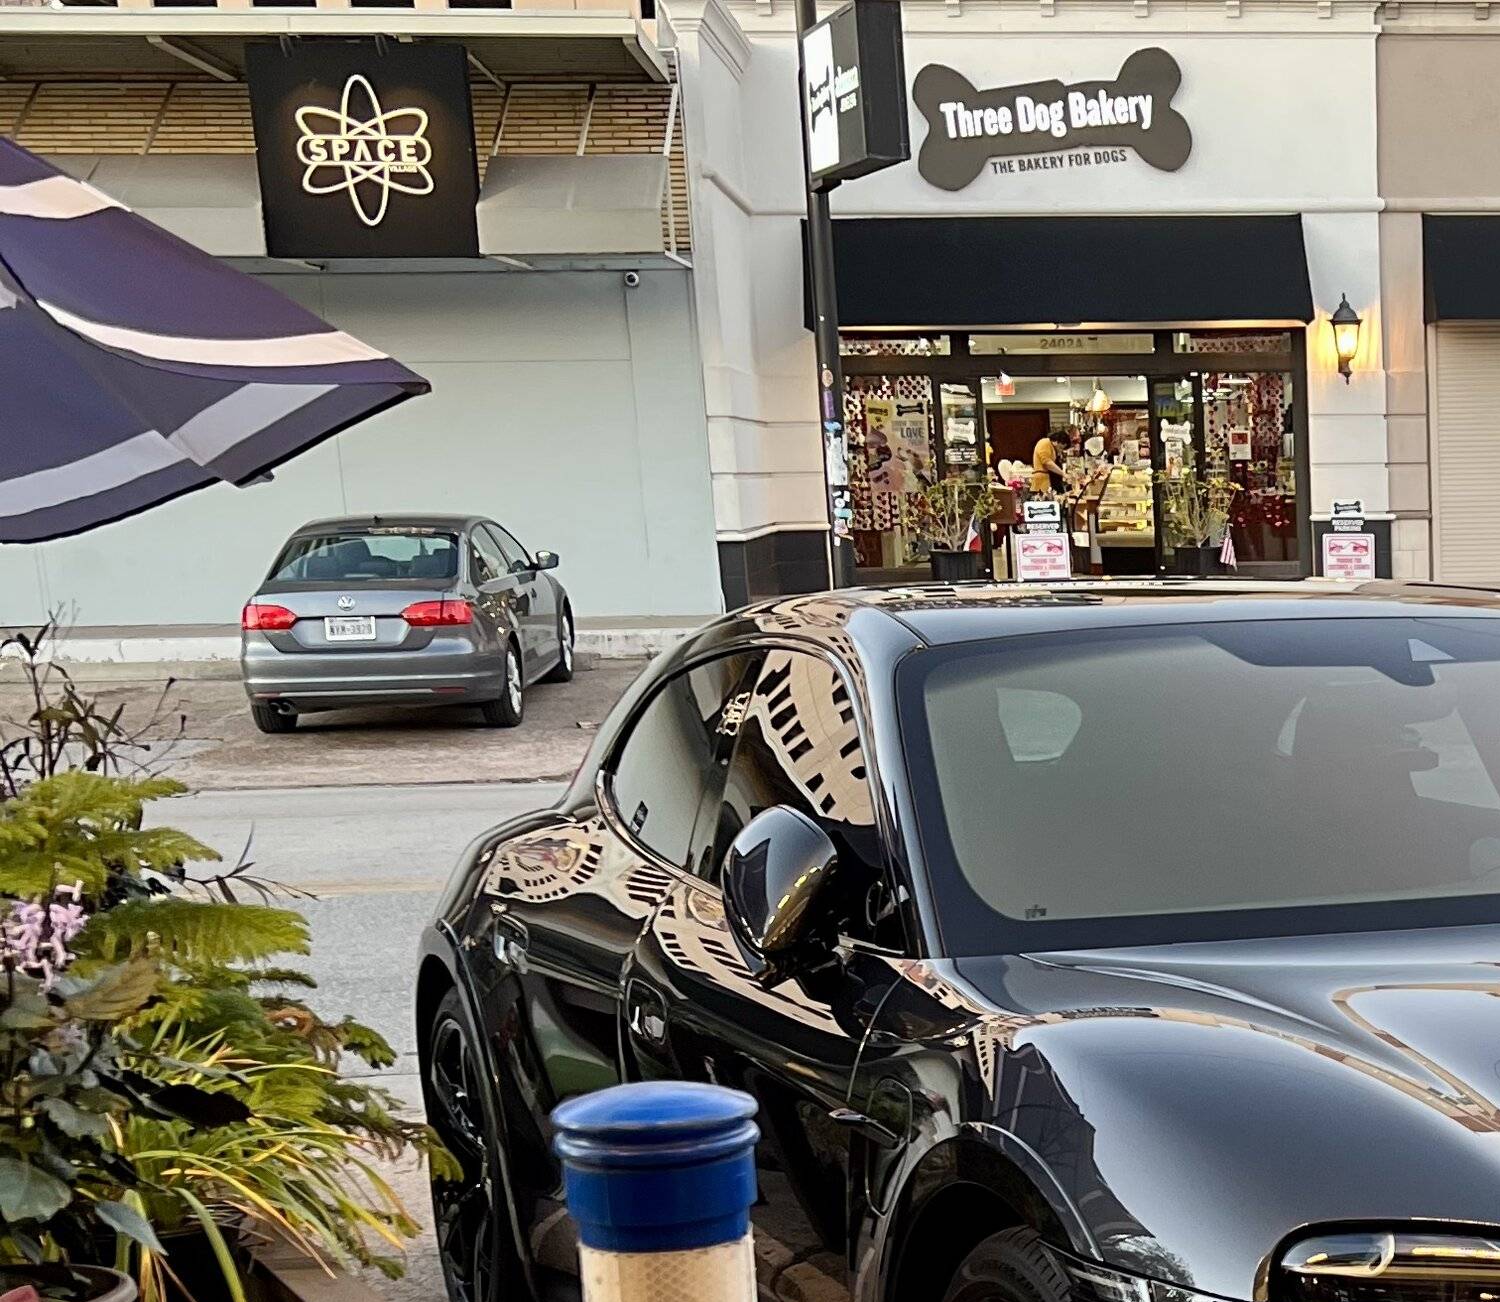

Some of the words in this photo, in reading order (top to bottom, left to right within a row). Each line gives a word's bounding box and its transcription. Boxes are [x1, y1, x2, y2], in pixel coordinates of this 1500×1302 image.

[939, 100, 1013, 139] Three
[1015, 96, 1067, 138] Dog
[1067, 89, 1153, 130] Bakery
[308, 139, 418, 162] SPACE
[991, 159, 1015, 174] THE
[1018, 155, 1065, 172] BAKERY
[1068, 152, 1091, 167] FOR
[1094, 149, 1128, 164] DOGS
[900, 427, 925, 439] LOVE
